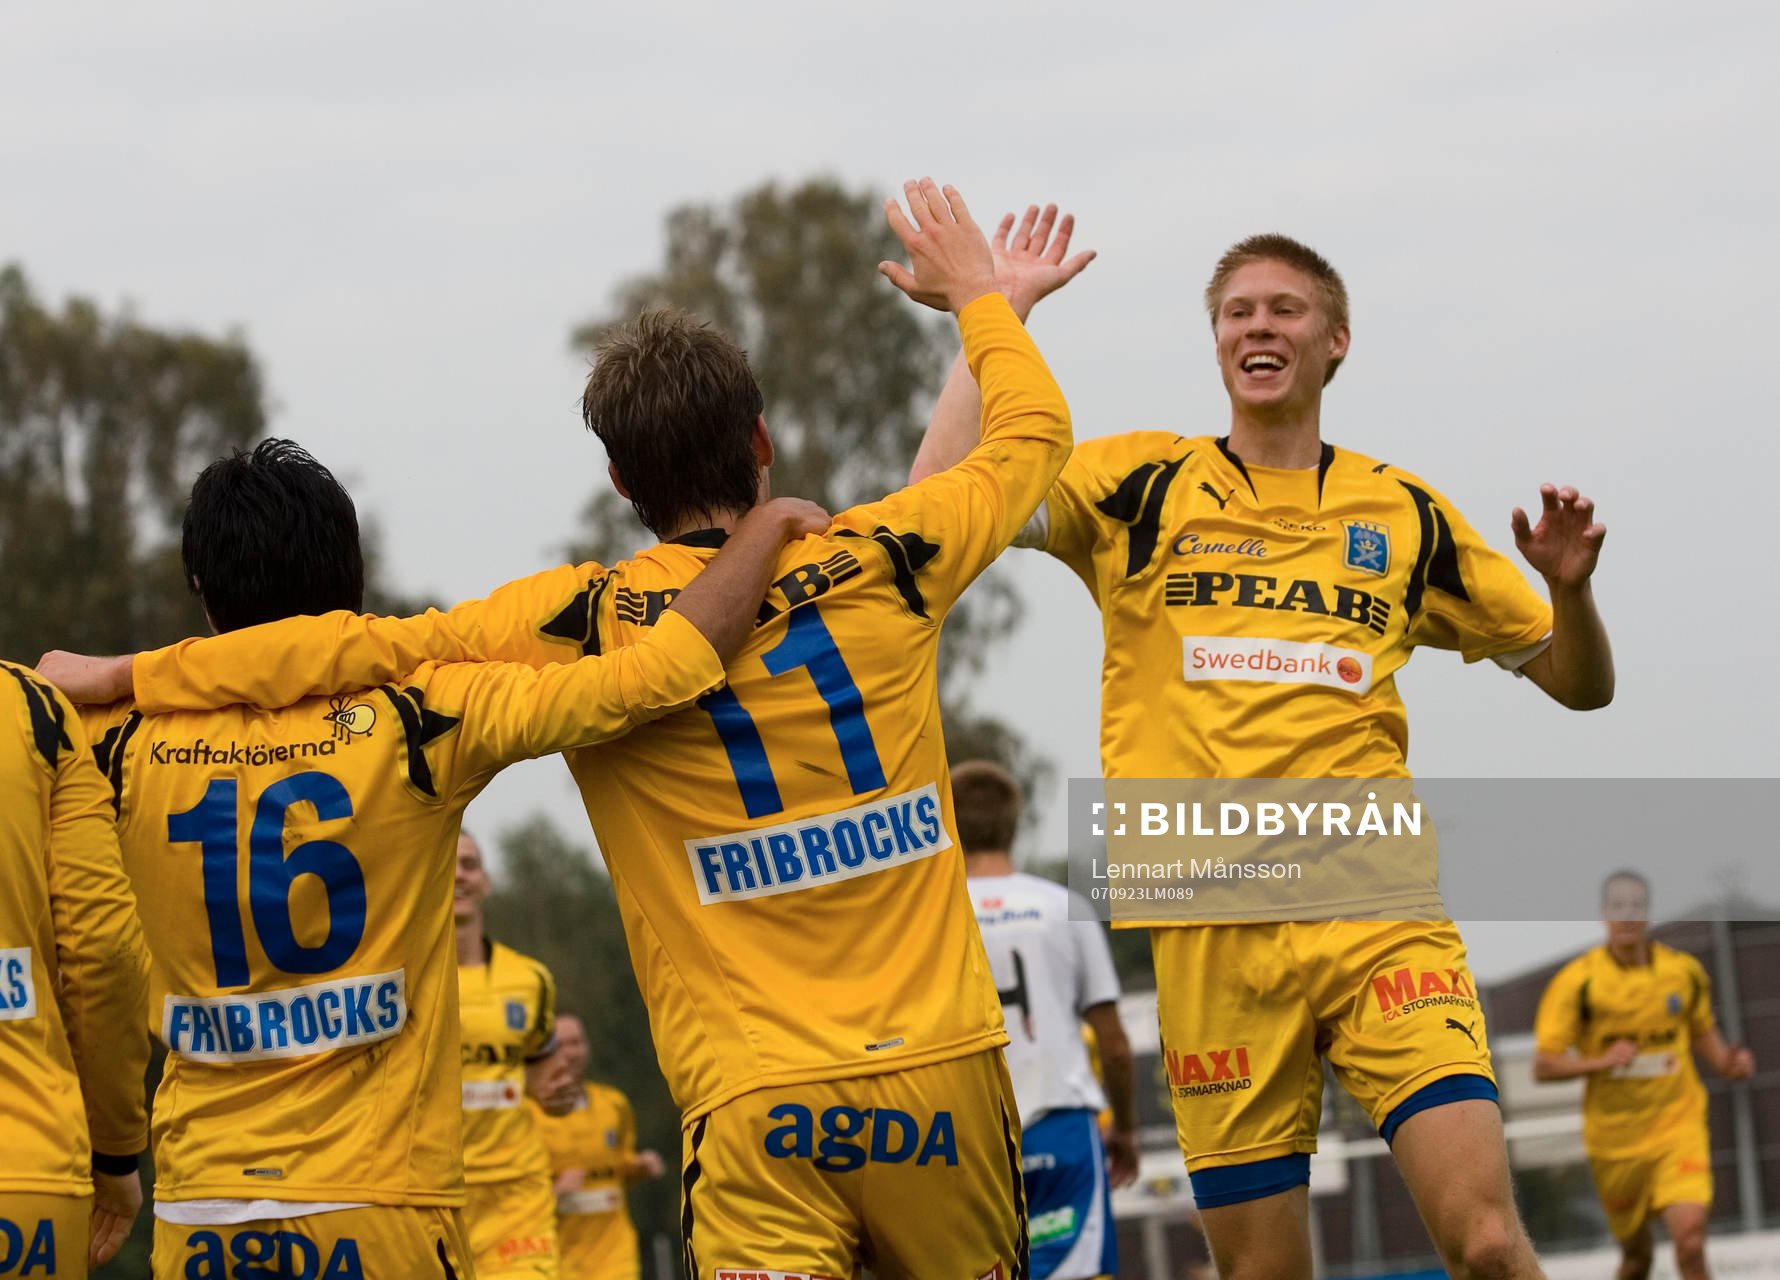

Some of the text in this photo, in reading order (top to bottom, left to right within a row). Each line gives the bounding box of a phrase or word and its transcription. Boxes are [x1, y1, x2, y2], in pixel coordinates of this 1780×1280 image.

[1190, 572, 1374, 625] PEAB
[1193, 647, 1331, 675] Swedbank
[696, 602, 888, 819] 11
[150, 738, 336, 767] Kraftaktörerna
[697, 795, 940, 895] FRIBROCKS
[167, 771, 367, 988] 16
[169, 981, 400, 1054] FRIBROCKS
[1371, 968, 1474, 1013] MAXI
[764, 1103, 958, 1172] agDA
[185, 1231, 364, 1280] agDA
